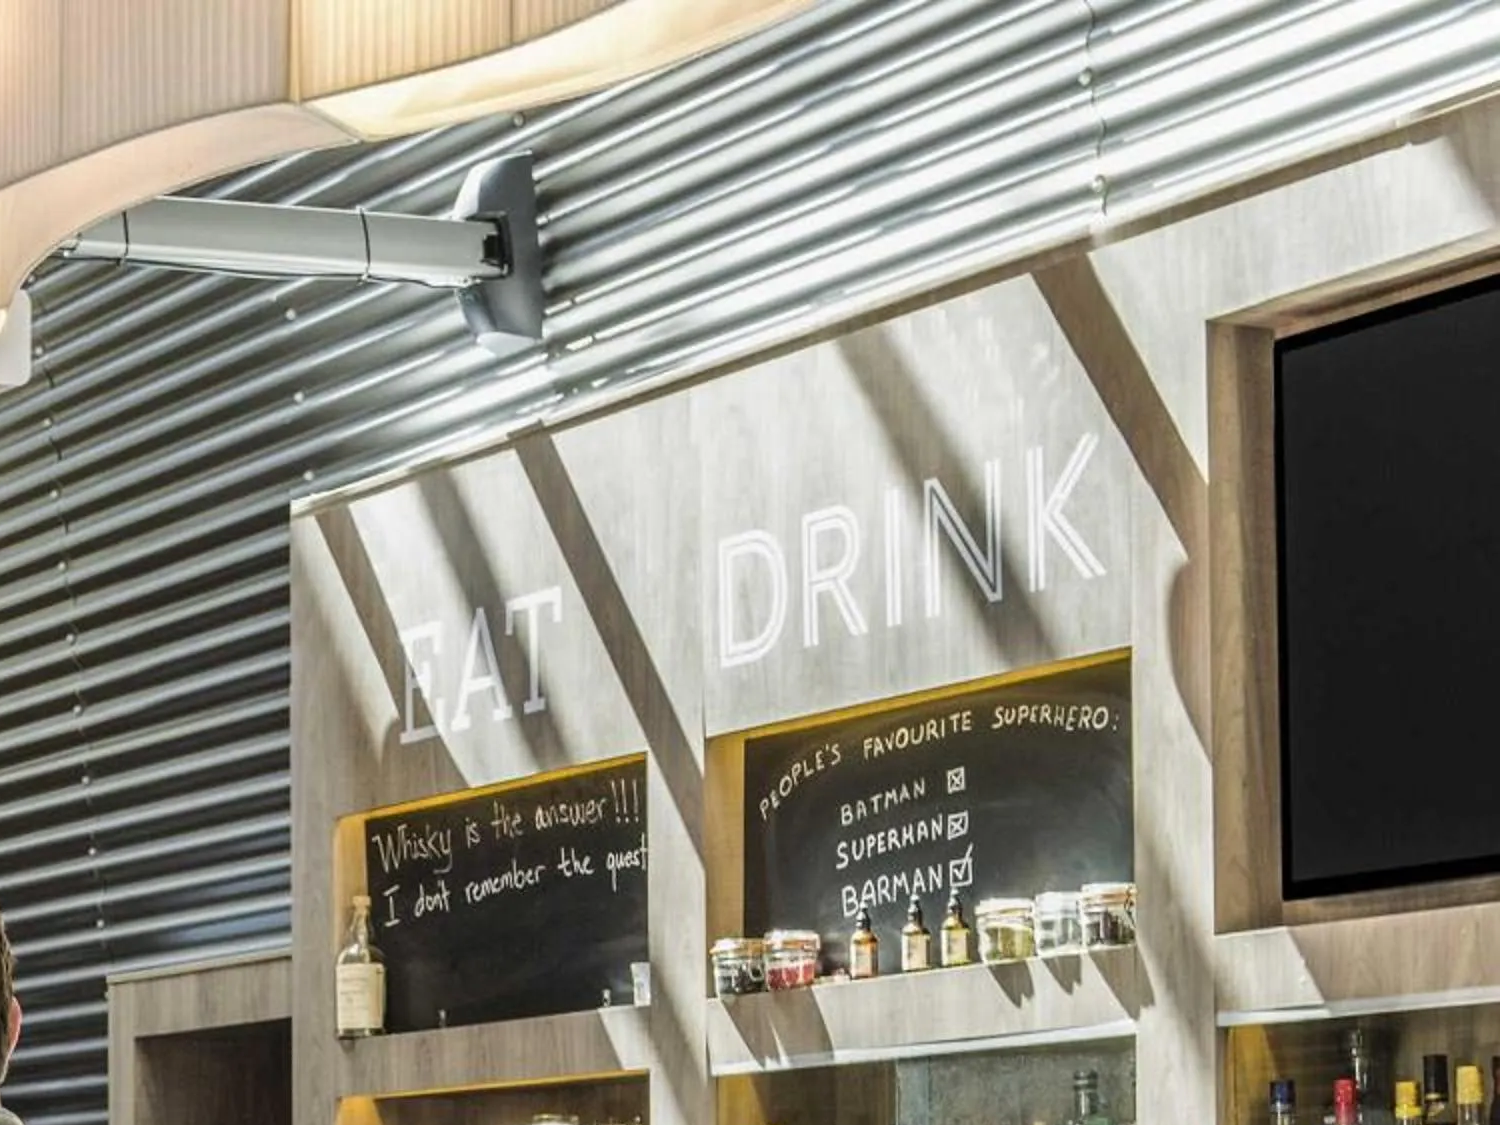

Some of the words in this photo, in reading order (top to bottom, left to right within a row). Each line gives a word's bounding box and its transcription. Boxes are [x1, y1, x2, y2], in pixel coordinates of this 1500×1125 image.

[399, 584, 562, 745] EAT
[717, 431, 1107, 669] DRINK
[758, 743, 842, 821] PEOPLE'S
[863, 710, 973, 761] FAVOURITE
[990, 703, 1120, 732] SUPERHERO:
[371, 820, 453, 874] Whisky
[464, 816, 482, 849] is
[490, 799, 525, 839] the
[840, 777, 926, 826] BATMAN
[835, 812, 944, 870] SUPERMAN
[382, 884, 401, 928] I
[464, 858, 547, 905] remember
[557, 846, 596, 878] the
[605, 831, 649, 893] quest
[840, 862, 944, 918] BARMAN
